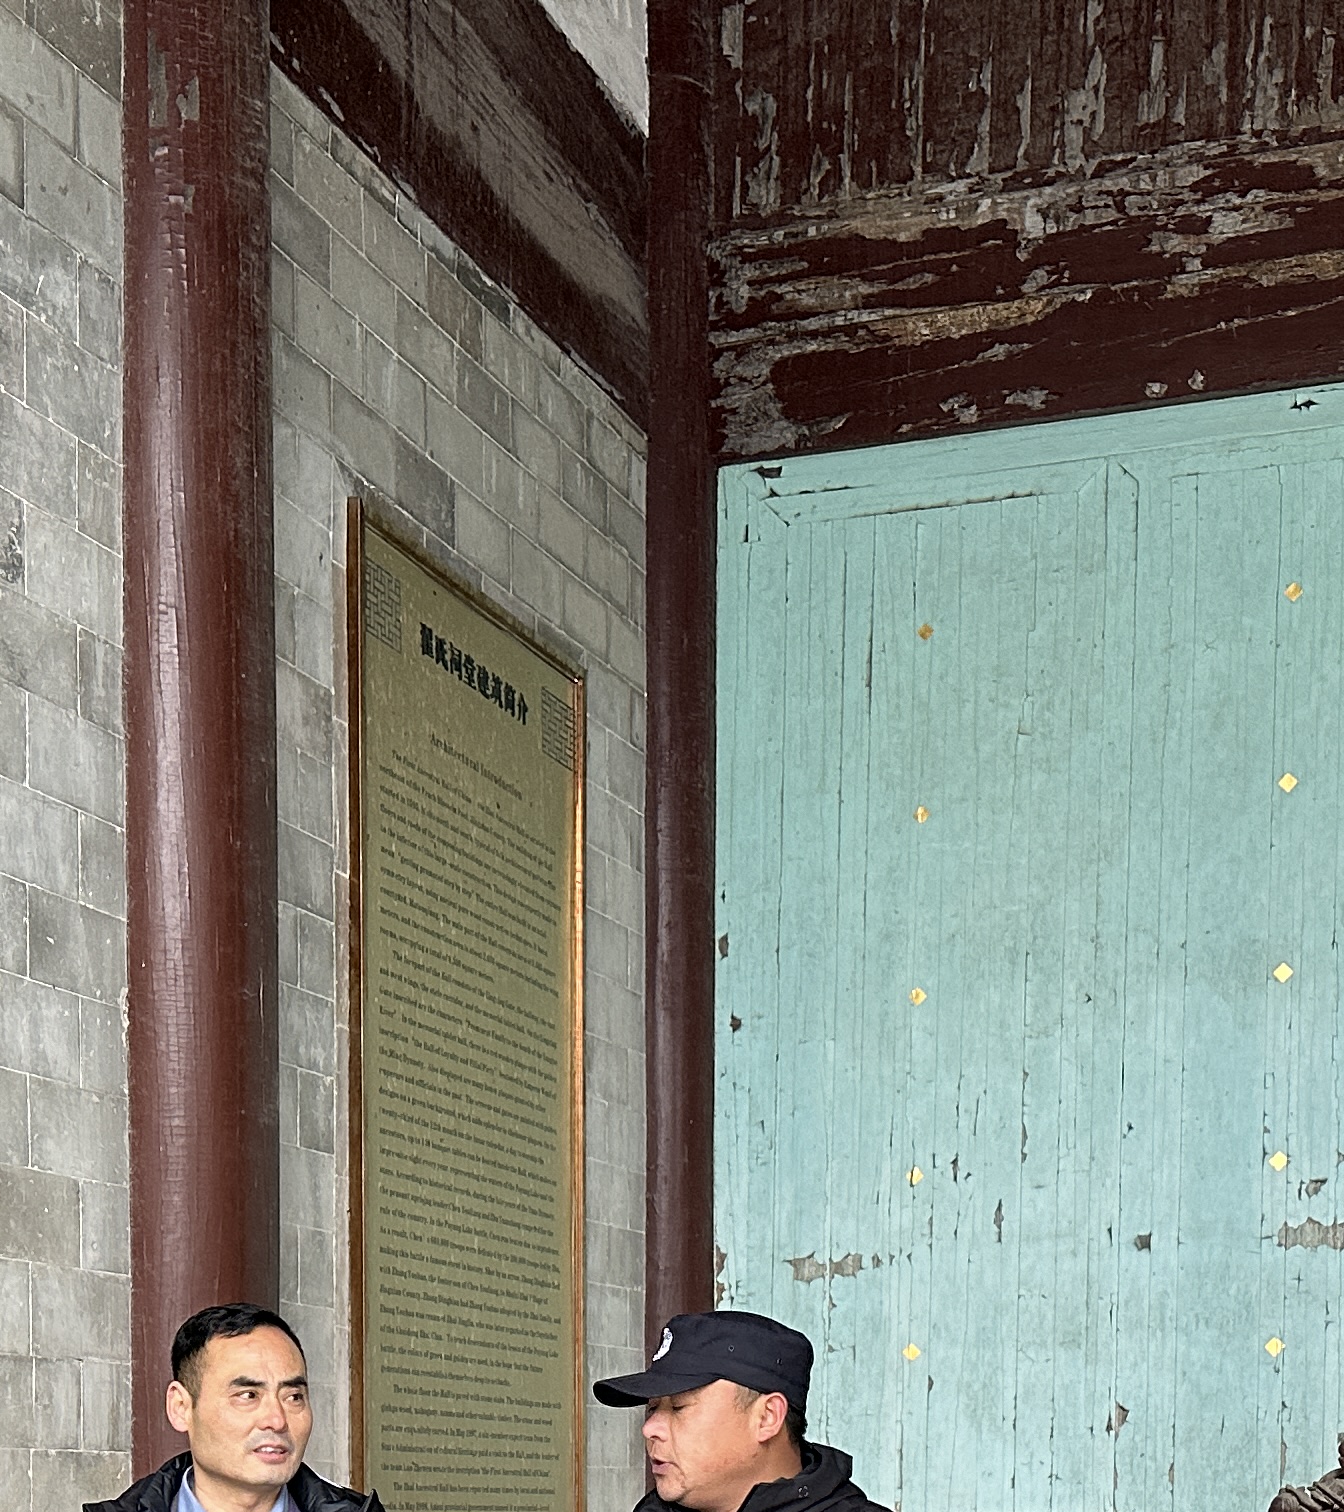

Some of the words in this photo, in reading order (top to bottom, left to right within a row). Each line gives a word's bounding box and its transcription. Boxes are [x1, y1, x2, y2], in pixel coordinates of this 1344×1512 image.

[420, 622, 528, 726] 翟氏祠堂建筑简介
